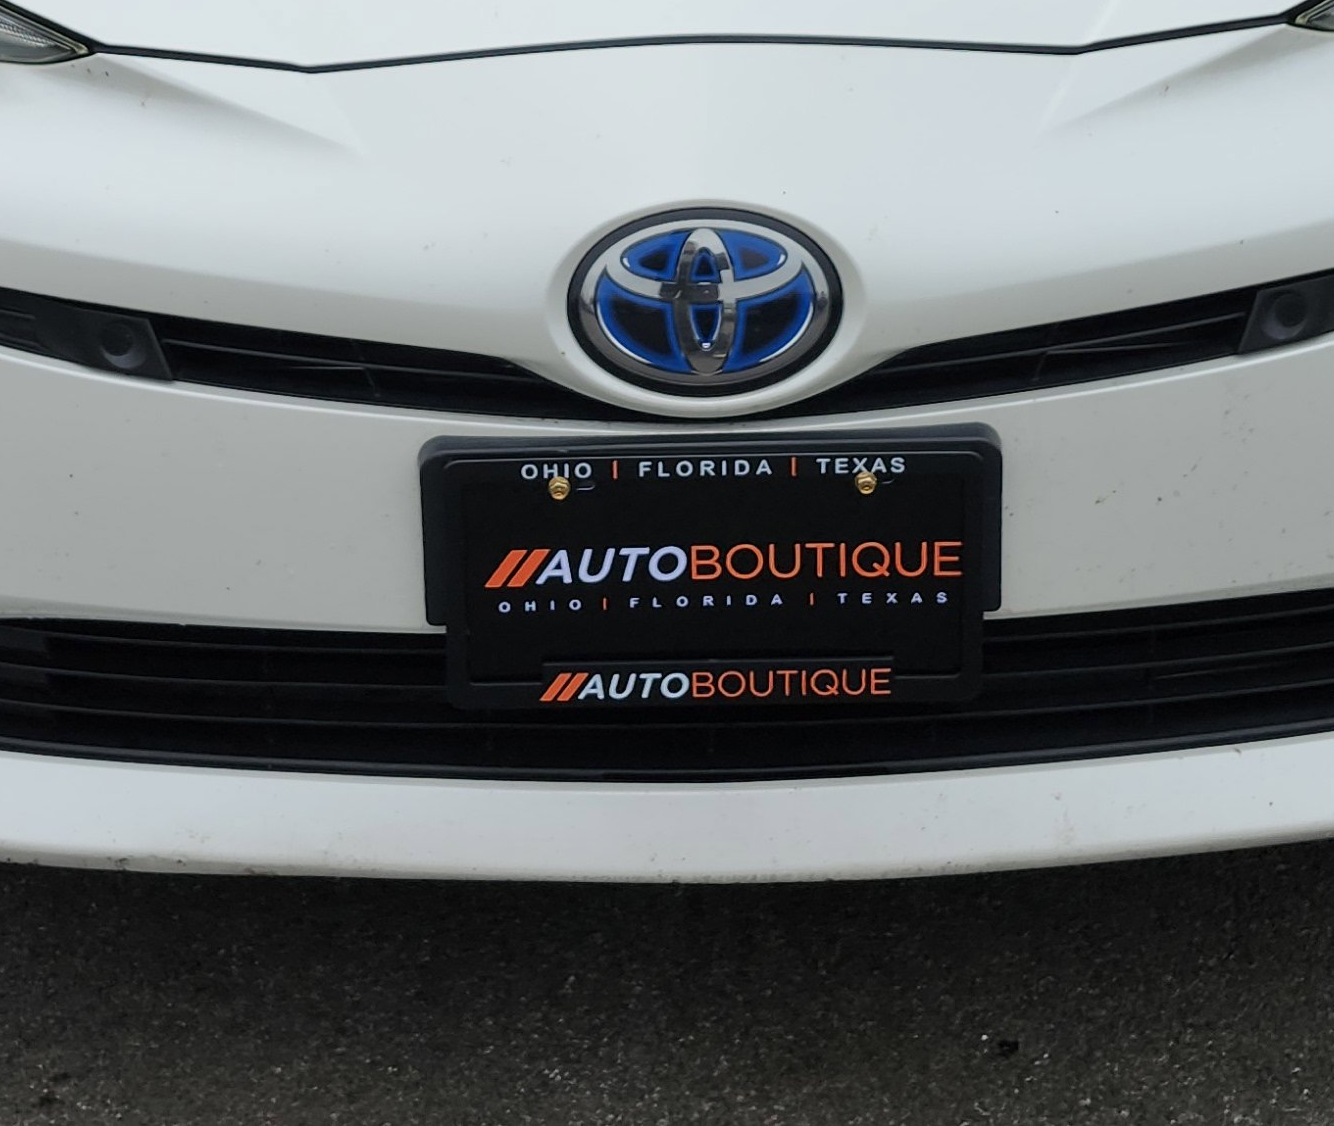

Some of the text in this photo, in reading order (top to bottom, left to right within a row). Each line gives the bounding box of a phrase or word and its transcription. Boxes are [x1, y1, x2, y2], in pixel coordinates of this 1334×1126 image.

[520, 456, 906, 480] OHIO FLORIDA TEXAS
[535, 540, 964, 585] AUTOBOUTIQUE
[497, 590, 949, 614] OHIO FLORIDA TEXAS
[577, 667, 892, 700] AUTOBOUTIQUE
